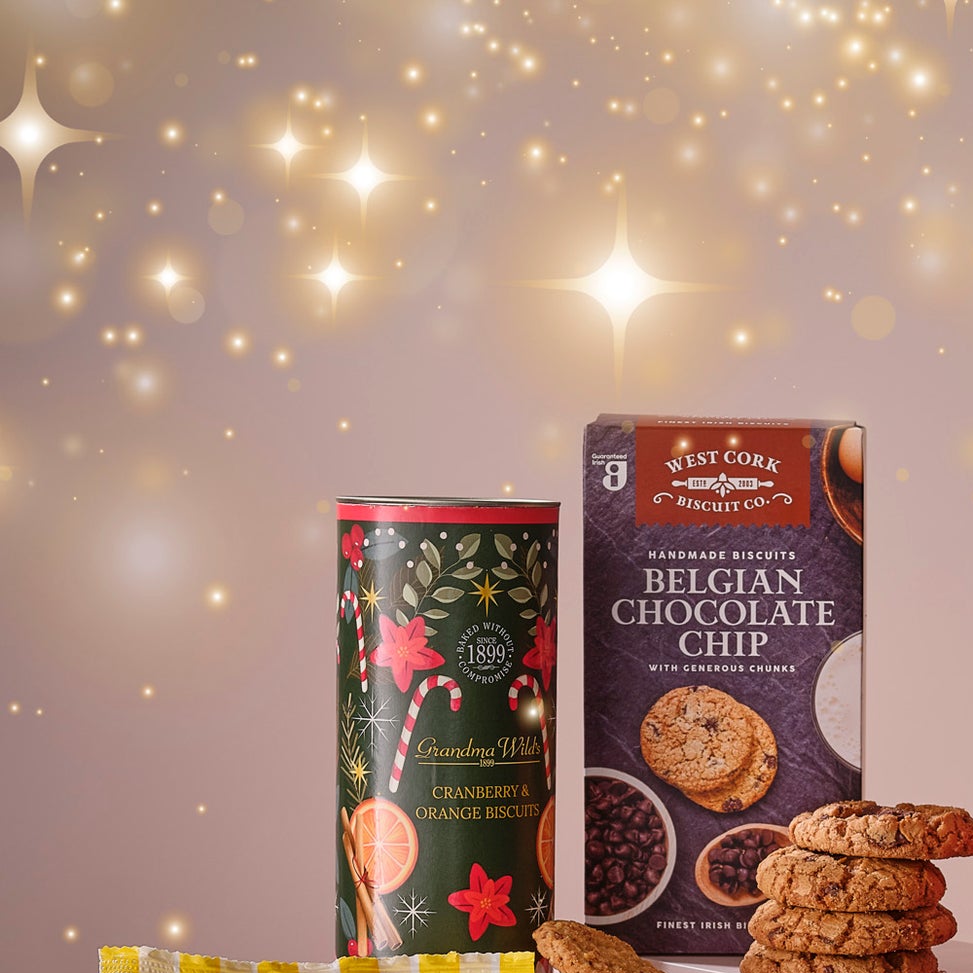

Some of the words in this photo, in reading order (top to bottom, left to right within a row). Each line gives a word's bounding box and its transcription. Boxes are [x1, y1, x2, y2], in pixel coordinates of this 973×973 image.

[664, 450, 719, 474] WEST
[723, 450, 782, 474] CORK
[738, 479, 753, 488] 2003
[676, 495, 740, 513] BISCUIT
[744, 496, 771, 510] CO.
[648, 550, 726, 560] HANDMADE
[732, 551, 796, 560] BISCUITS
[643, 568, 803, 594] BELGIAN
[611, 599, 836, 626] CHOCOLATE
[456, 624, 480, 653] BAKED
[483, 622, 514, 653] WITHOUT
[678, 631, 768, 657] CHIP
[467, 644, 506, 664] 1899
[458, 660, 513, 684] COMPROMISE
[648, 664, 679, 672] WITH
[683, 664, 745, 672] GENEROUS
[749, 664, 796, 673] CHUNKS
[414, 736, 495, 758] Grandma
[498, 736, 541, 758] Wild's
[480, 759, 495, 768] 1899
[432, 784, 519, 799] CRANBERRY
[521, 784, 530, 797] &
[416, 806, 482, 820] ORANGE
[486, 804, 540, 820] BISCUITS
[656, 921, 696, 929] FINEST
[700, 922, 731, 930] IRISH
